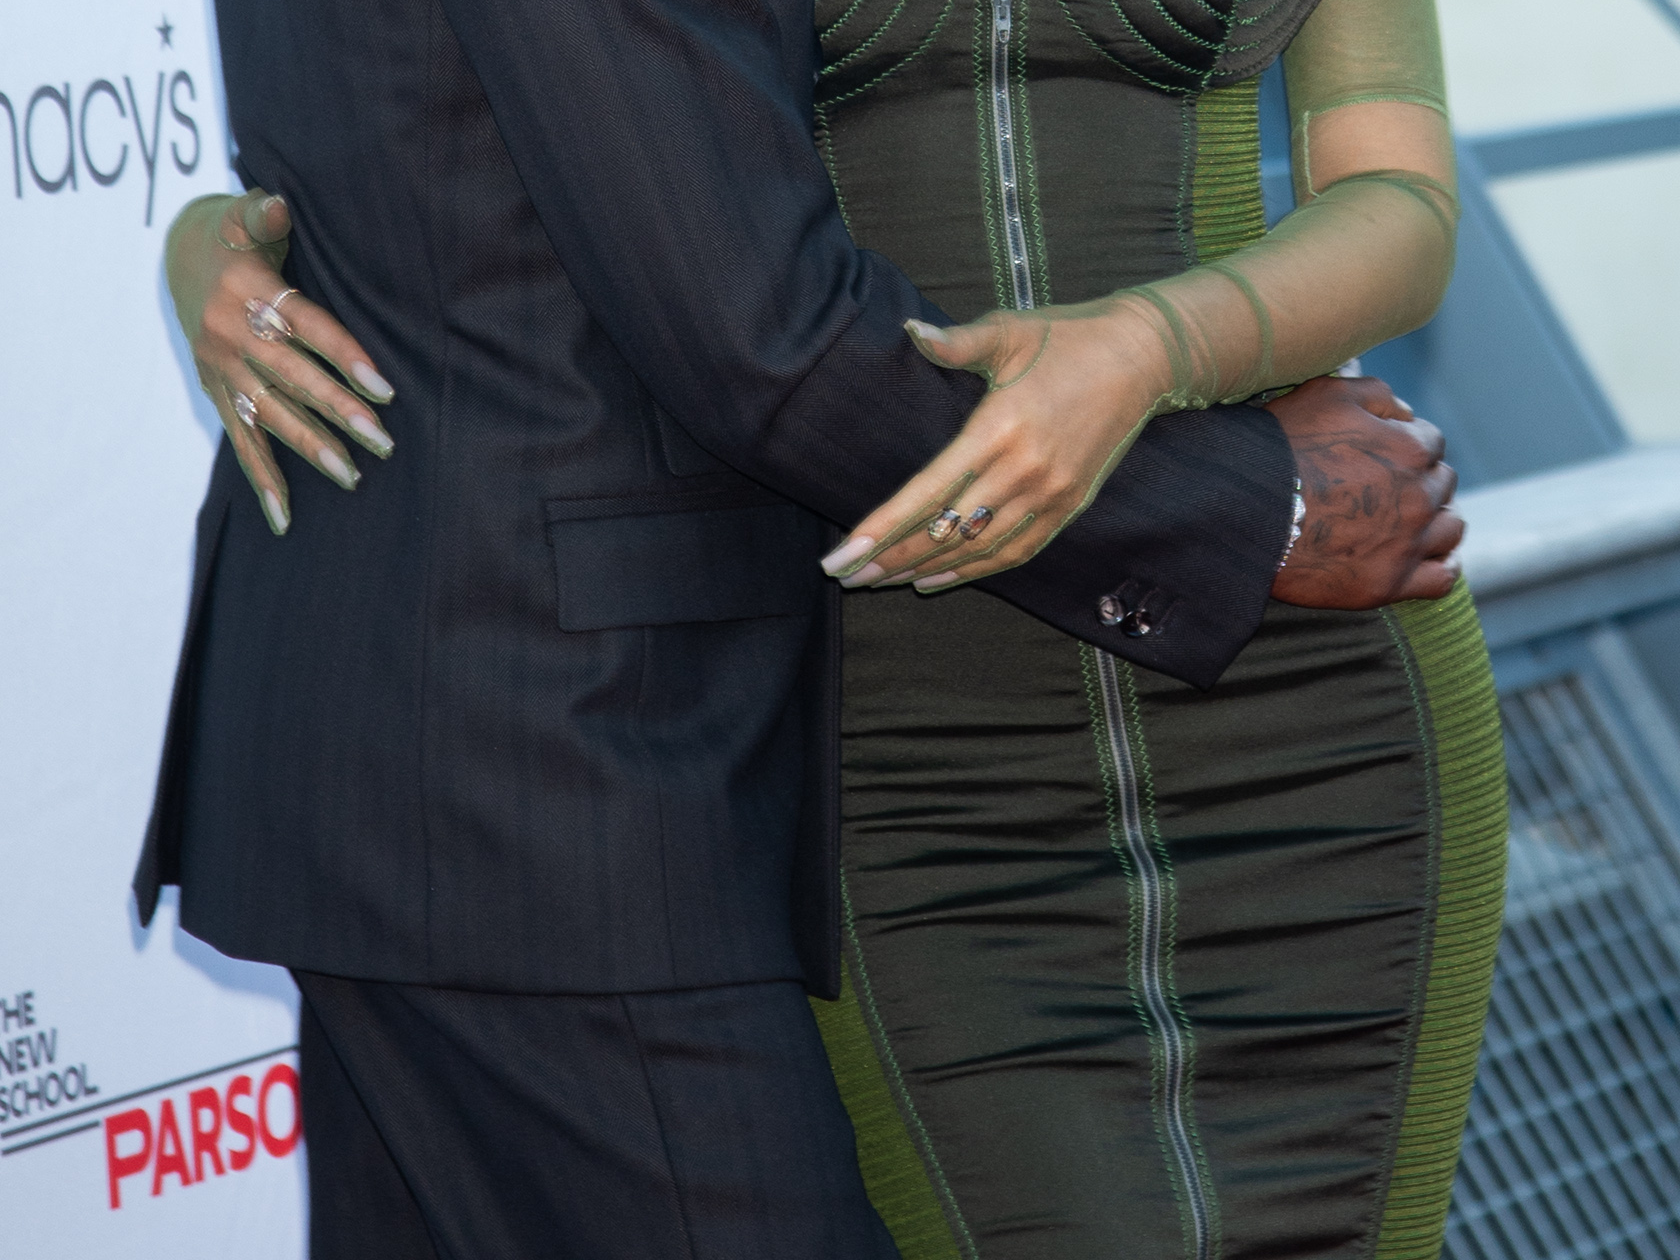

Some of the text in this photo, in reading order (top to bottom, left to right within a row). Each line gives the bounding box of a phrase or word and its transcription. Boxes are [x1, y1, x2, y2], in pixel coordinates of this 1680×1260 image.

[0, 991, 34, 1032] HE
[0, 1027, 57, 1075] NEW
[0, 1063, 99, 1123] SCHOOL
[104, 1062, 302, 1210] PARSO
